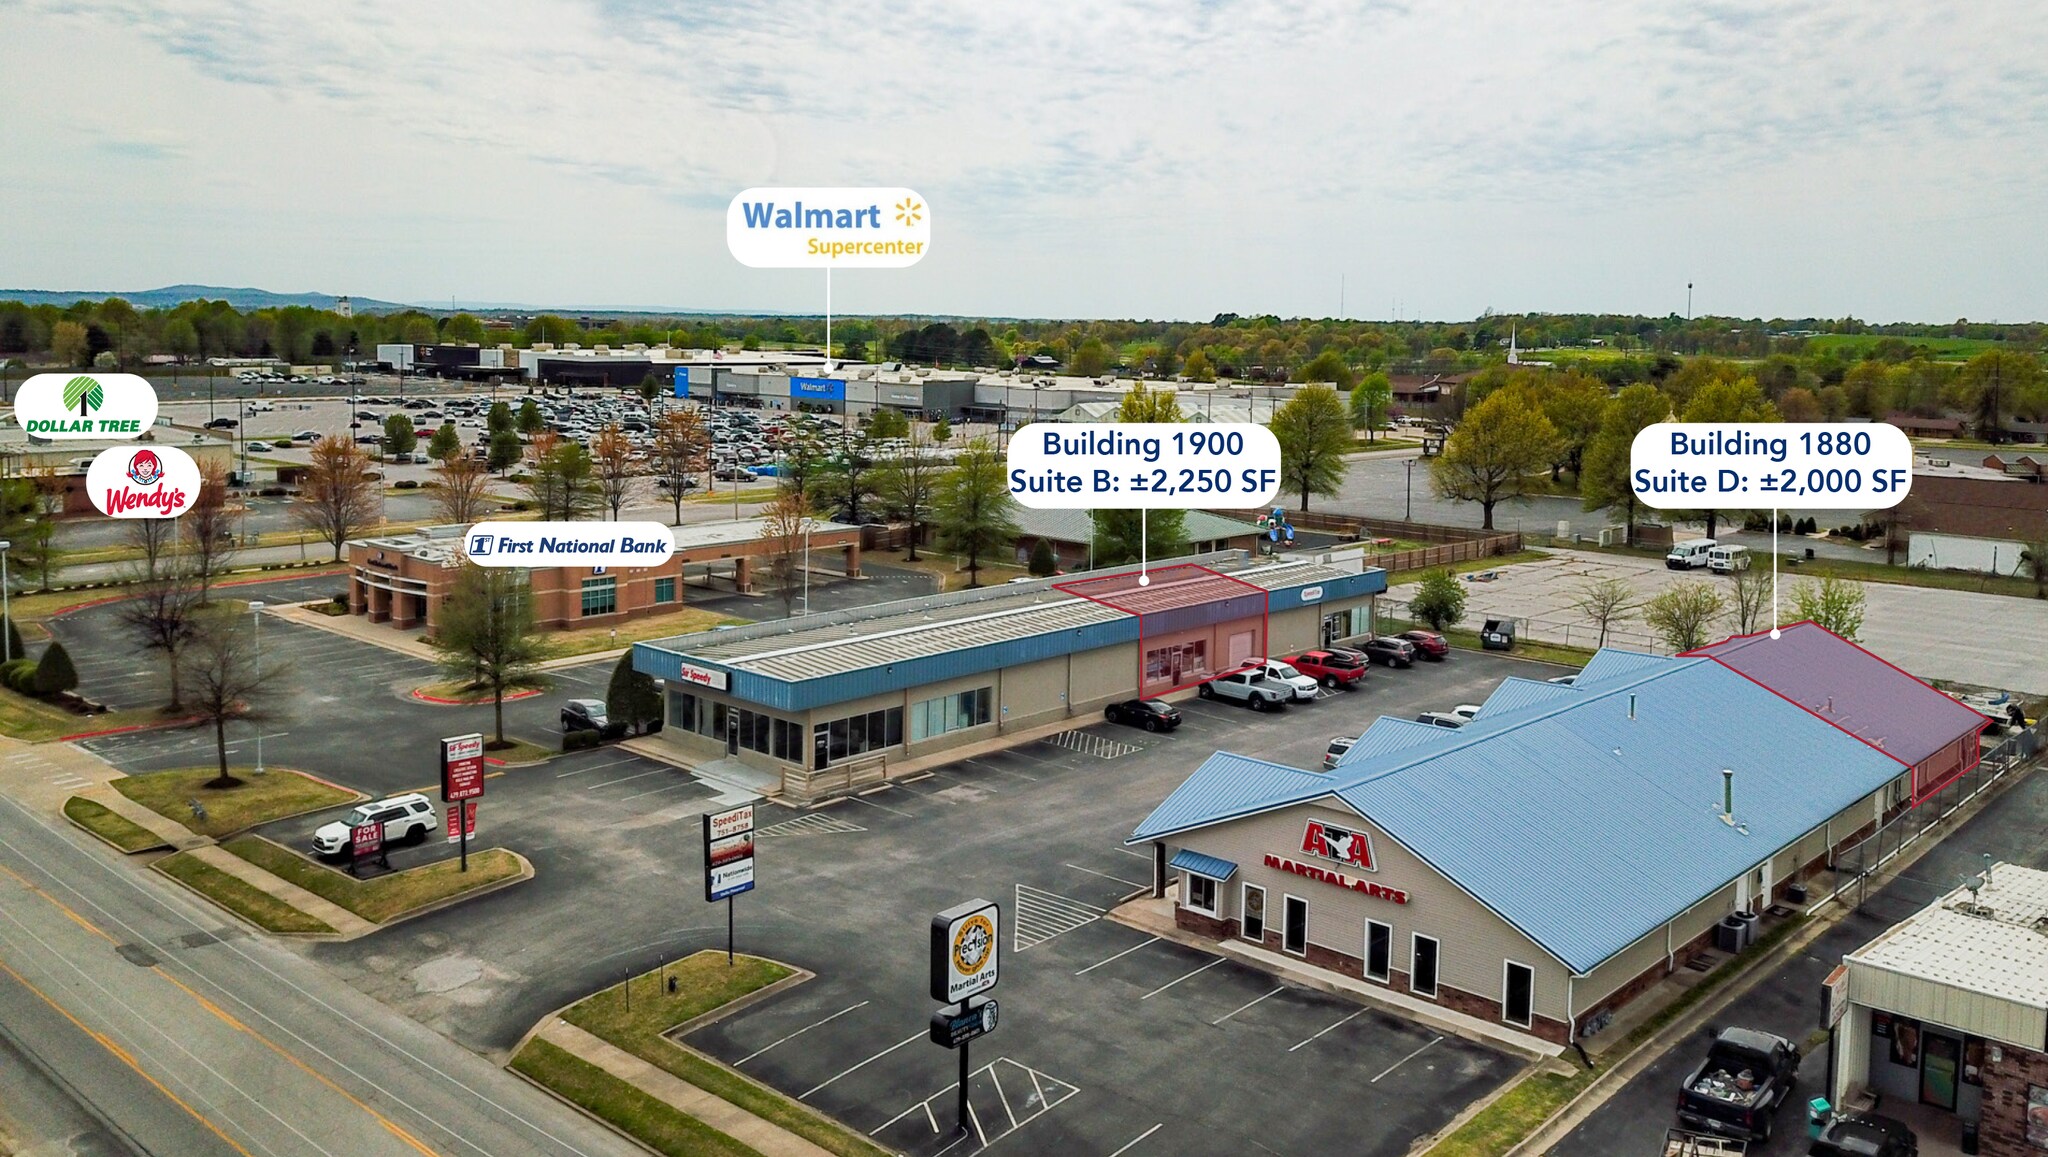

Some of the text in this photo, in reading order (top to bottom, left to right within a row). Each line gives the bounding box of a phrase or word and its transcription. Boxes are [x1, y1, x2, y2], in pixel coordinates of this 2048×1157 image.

[800, 382, 826, 392] Walmart
[690, 670, 712, 685] Speedy
[458, 741, 480, 752] Speedy
[713, 811, 752, 828] SpeediTax
[355, 832, 378, 843] SALE
[357, 825, 376, 835] FOR
[1302, 822, 1372, 868] ATA
[1264, 854, 1407, 904] MARTIAL ARTS
[950, 974, 979, 994] Martial
[979, 969, 995, 983] Arts
